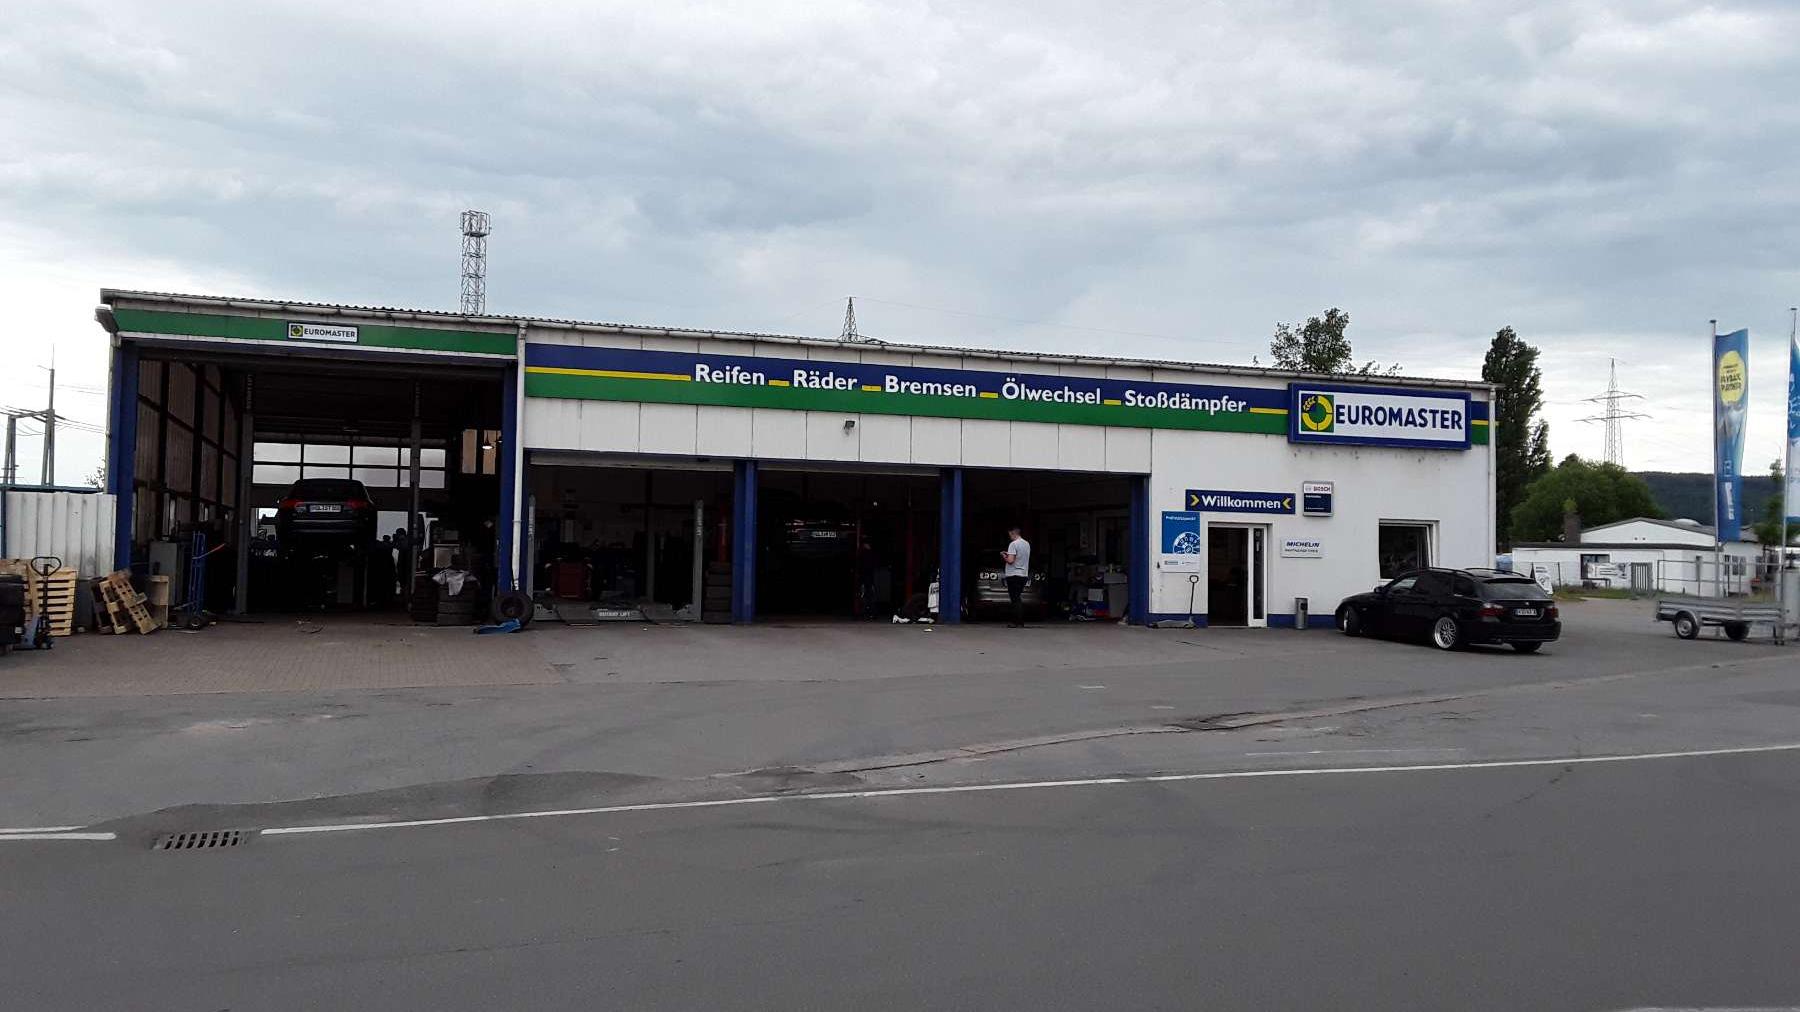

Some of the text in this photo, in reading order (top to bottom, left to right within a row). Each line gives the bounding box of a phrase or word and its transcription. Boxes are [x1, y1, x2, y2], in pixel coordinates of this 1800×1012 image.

[304, 328, 355, 338] EUROMASTER
[695, 363, 1247, 416] Reifen Räder Bremsen Ölwechsel Stoßdämpfer
[1335, 404, 1463, 430] EUROMASTER
[1201, 494, 1281, 509] Willkommen
